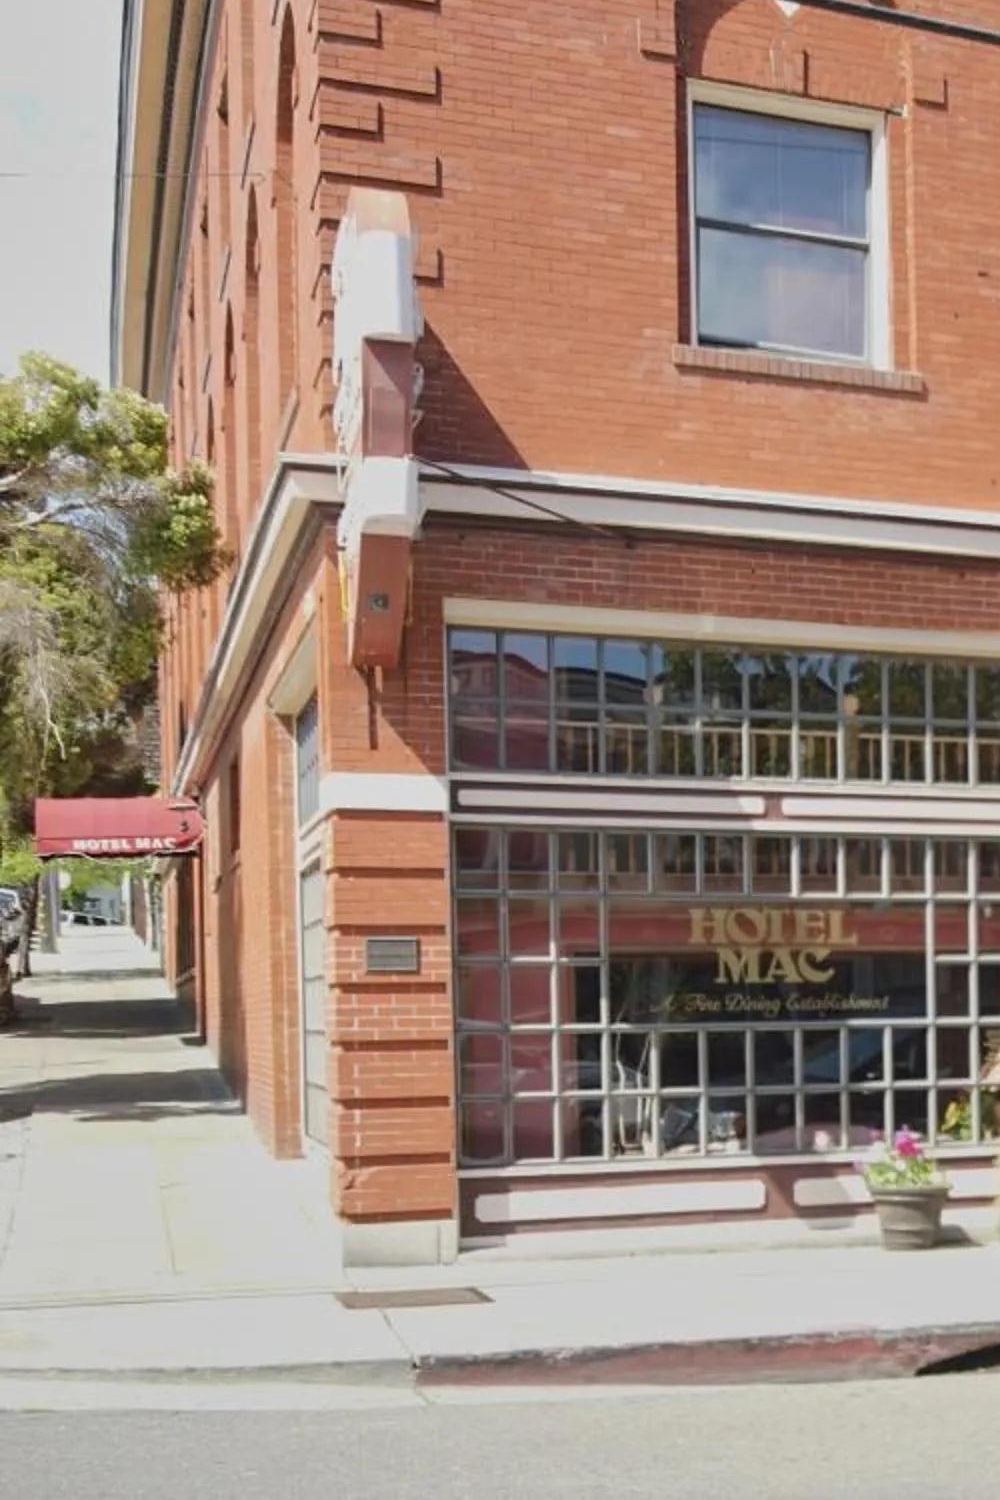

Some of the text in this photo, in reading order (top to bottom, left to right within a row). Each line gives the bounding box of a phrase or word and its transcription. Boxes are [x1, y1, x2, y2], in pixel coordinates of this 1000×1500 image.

[73, 837, 177, 850] HOTEL MAC
[688, 908, 857, 945] HOTEL
[714, 947, 835, 984] MAC
[725, 993, 781, 1018] Dining
